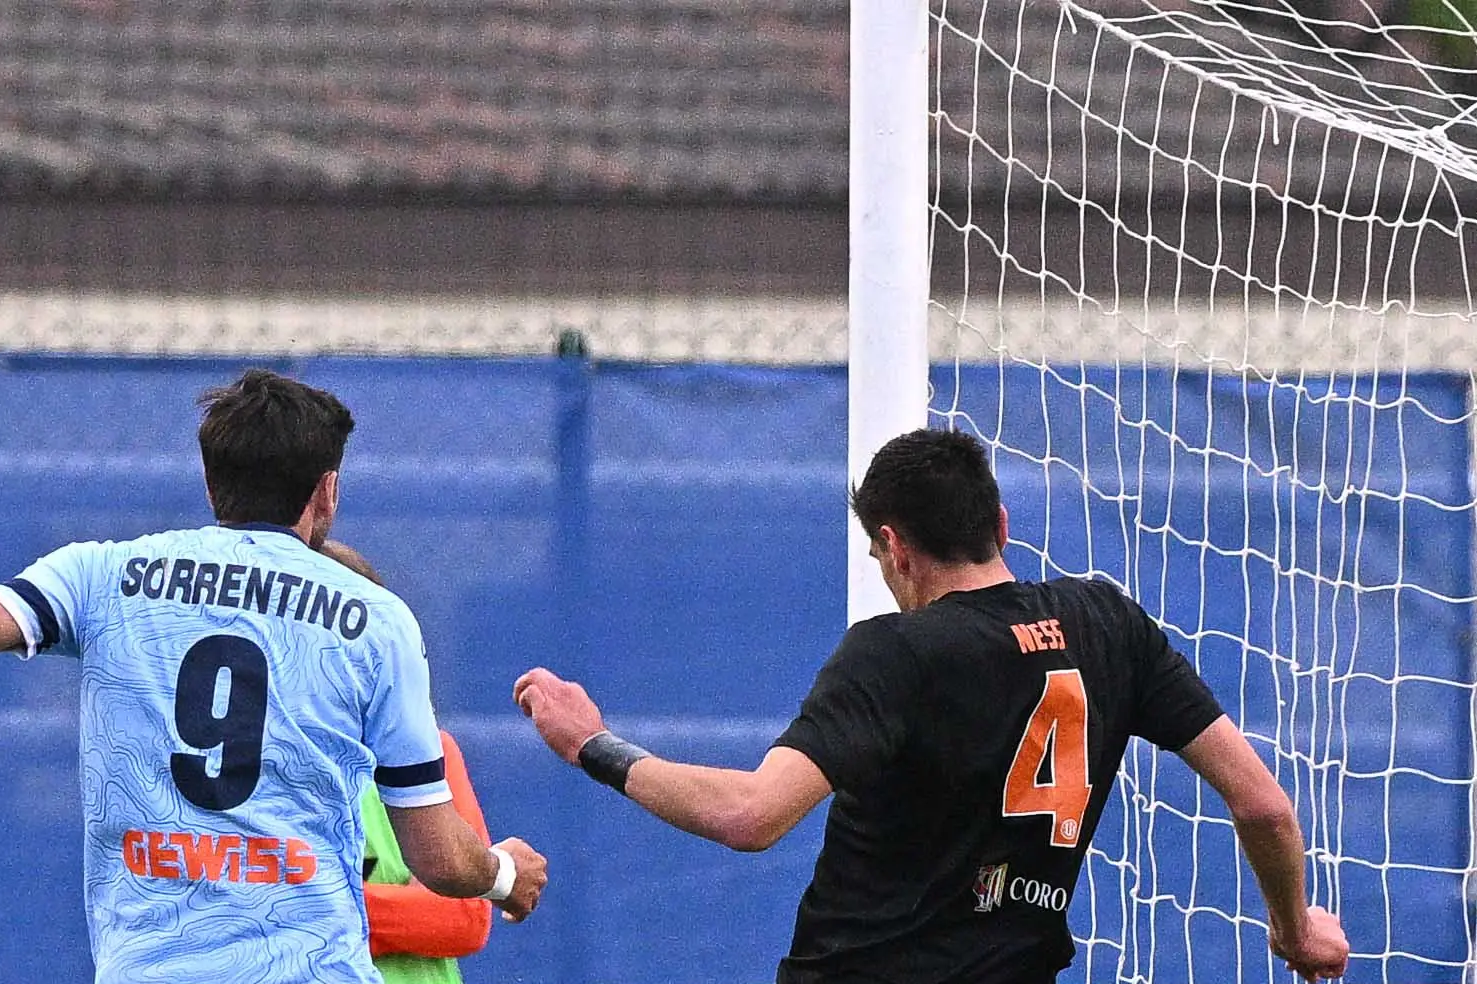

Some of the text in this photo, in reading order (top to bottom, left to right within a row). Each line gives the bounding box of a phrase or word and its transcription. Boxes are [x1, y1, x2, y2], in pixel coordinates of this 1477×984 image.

[121, 557, 368, 641] SORRENTINO
[1010, 618, 1068, 653] NESS
[170, 634, 268, 811] 9
[1002, 668, 1093, 848] 4
[1009, 877, 1069, 912] CORO
